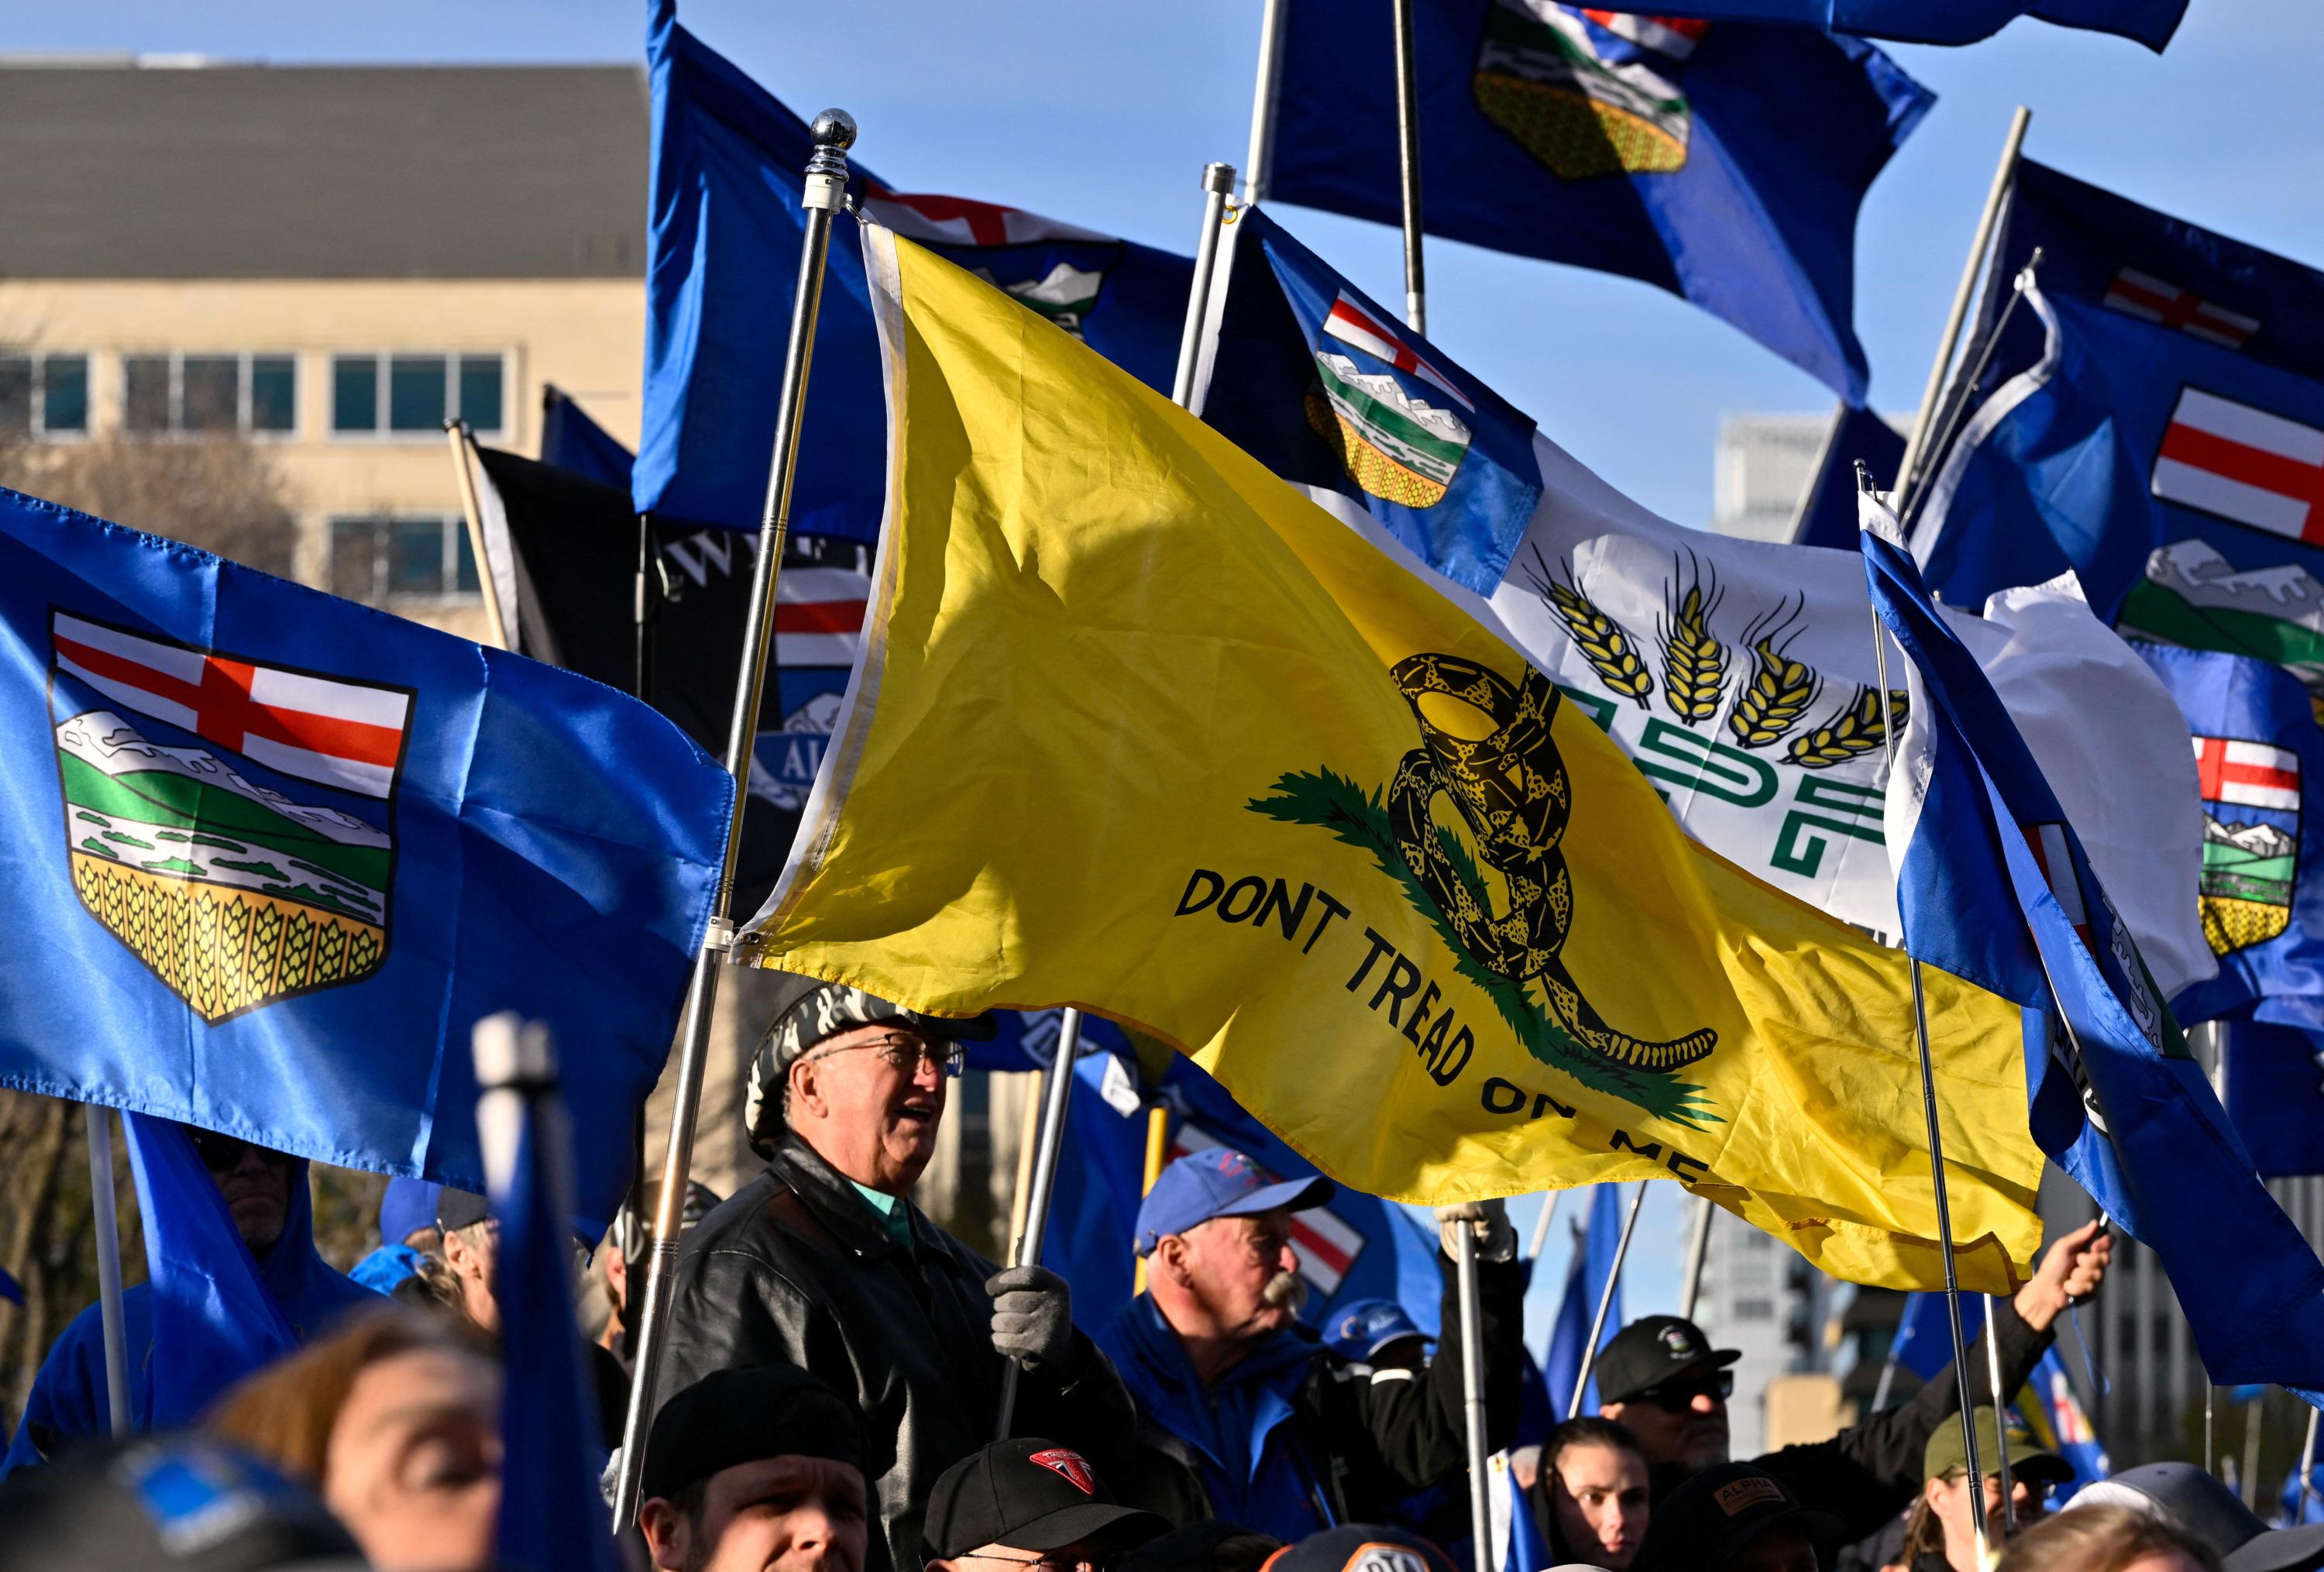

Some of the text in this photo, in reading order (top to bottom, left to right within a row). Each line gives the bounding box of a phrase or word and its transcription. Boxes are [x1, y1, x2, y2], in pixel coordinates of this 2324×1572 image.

[1174, 869, 1352, 955] DONT
[1345, 926, 1475, 1087] TREAD
[1481, 1076, 1577, 1120] ON
[1722, 1480, 1773, 1501] ALPHA
